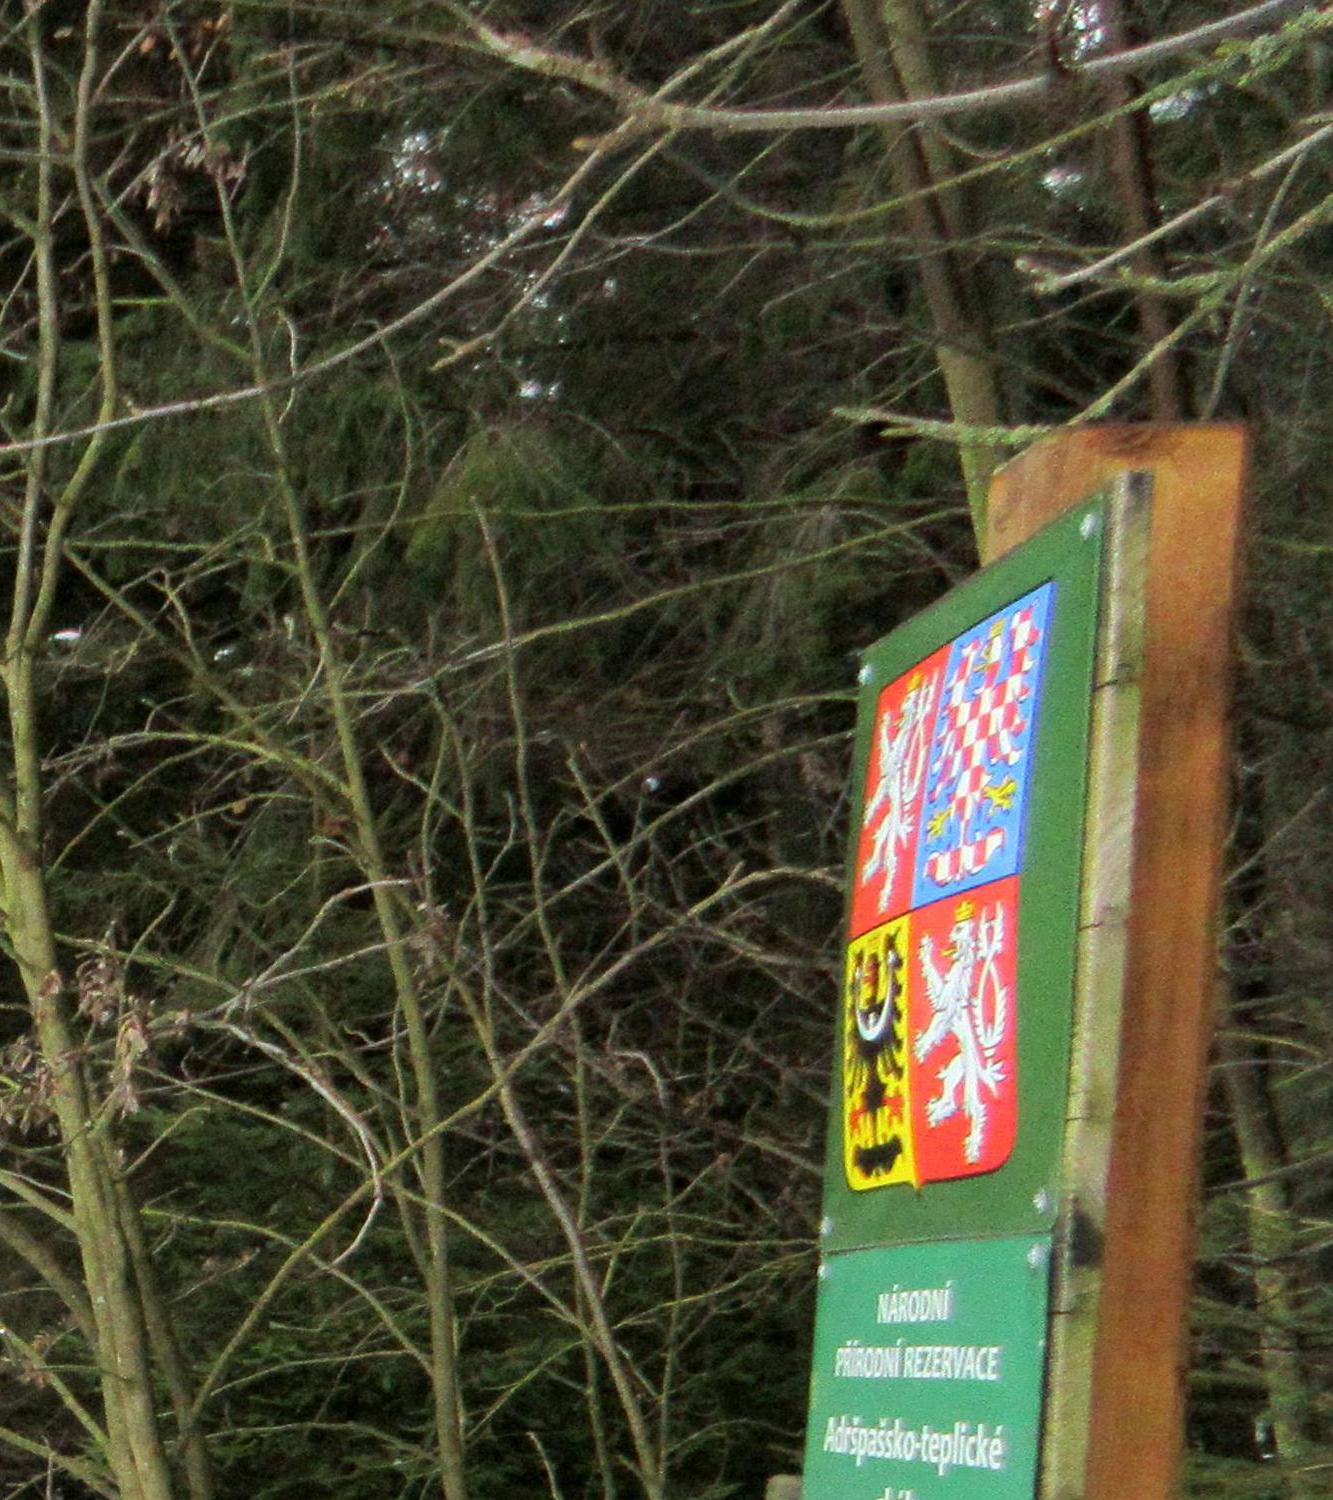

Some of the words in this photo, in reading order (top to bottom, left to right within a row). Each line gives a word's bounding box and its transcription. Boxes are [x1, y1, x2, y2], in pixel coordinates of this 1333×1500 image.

[877, 1280, 956, 1323] NÁRODNÍ
[835, 1338, 904, 1378] PŘÍRODNÍ
[904, 1345, 1003, 1381] REZERVACE
[824, 1416, 1008, 1477] Adršpašsko-teplické
